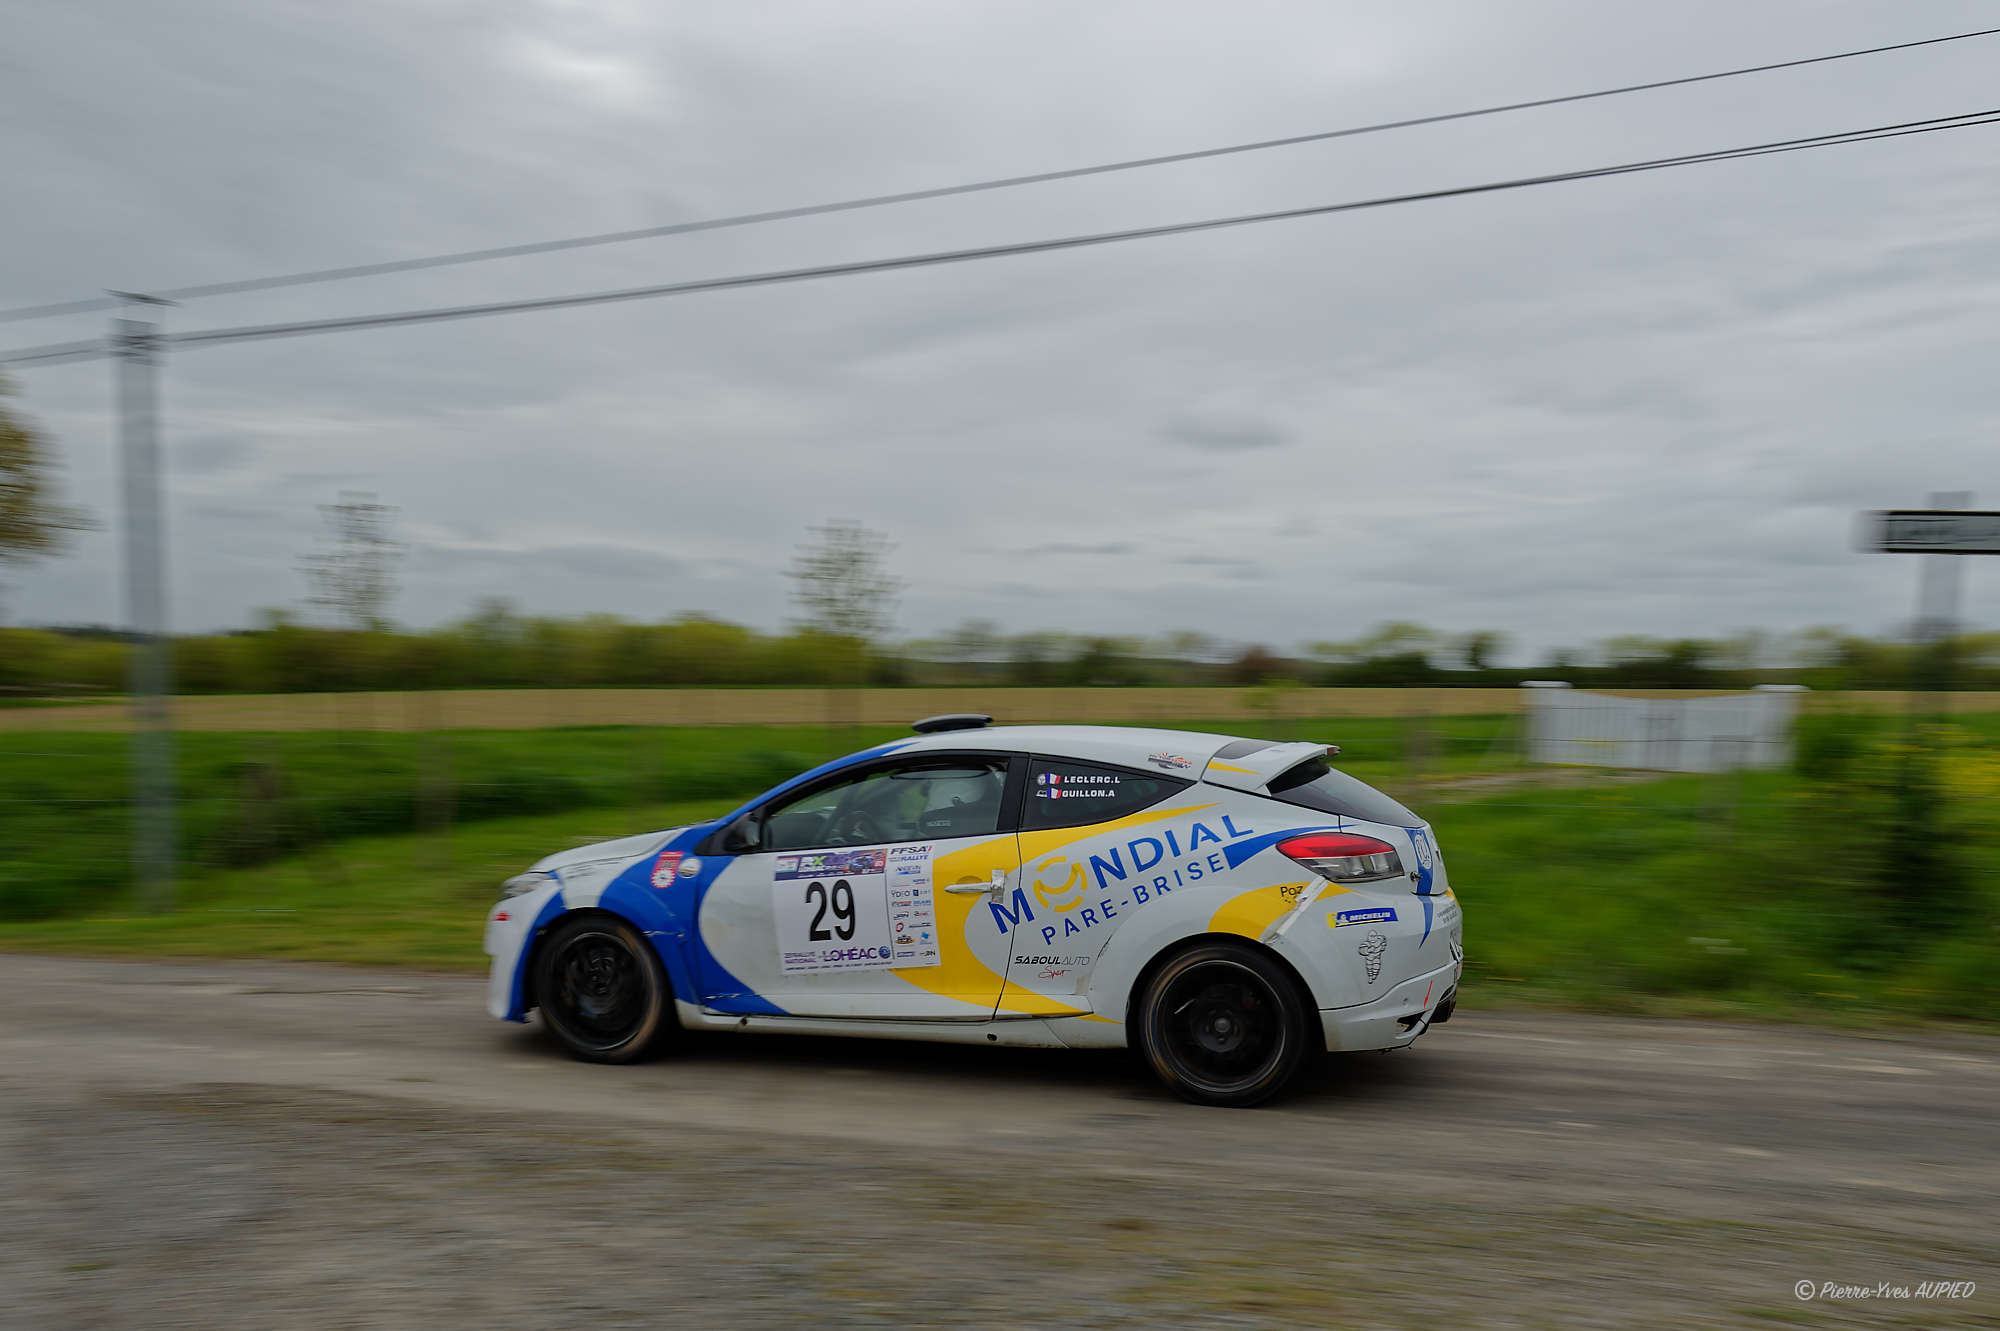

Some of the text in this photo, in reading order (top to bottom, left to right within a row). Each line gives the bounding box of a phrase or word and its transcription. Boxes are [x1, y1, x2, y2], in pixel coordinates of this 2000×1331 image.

[1064, 775, 1121, 784] LECLERC.L
[1062, 789, 1116, 798] GUILLON.A
[891, 846, 928, 854] FFSA
[988, 815, 1254, 934] MONDIAL
[1041, 853, 1225, 945] PARE-BRISE
[805, 879, 855, 942] 29
[1349, 911, 1391, 921] MICHELIN
[823, 946, 878, 962] LOHÉAC
